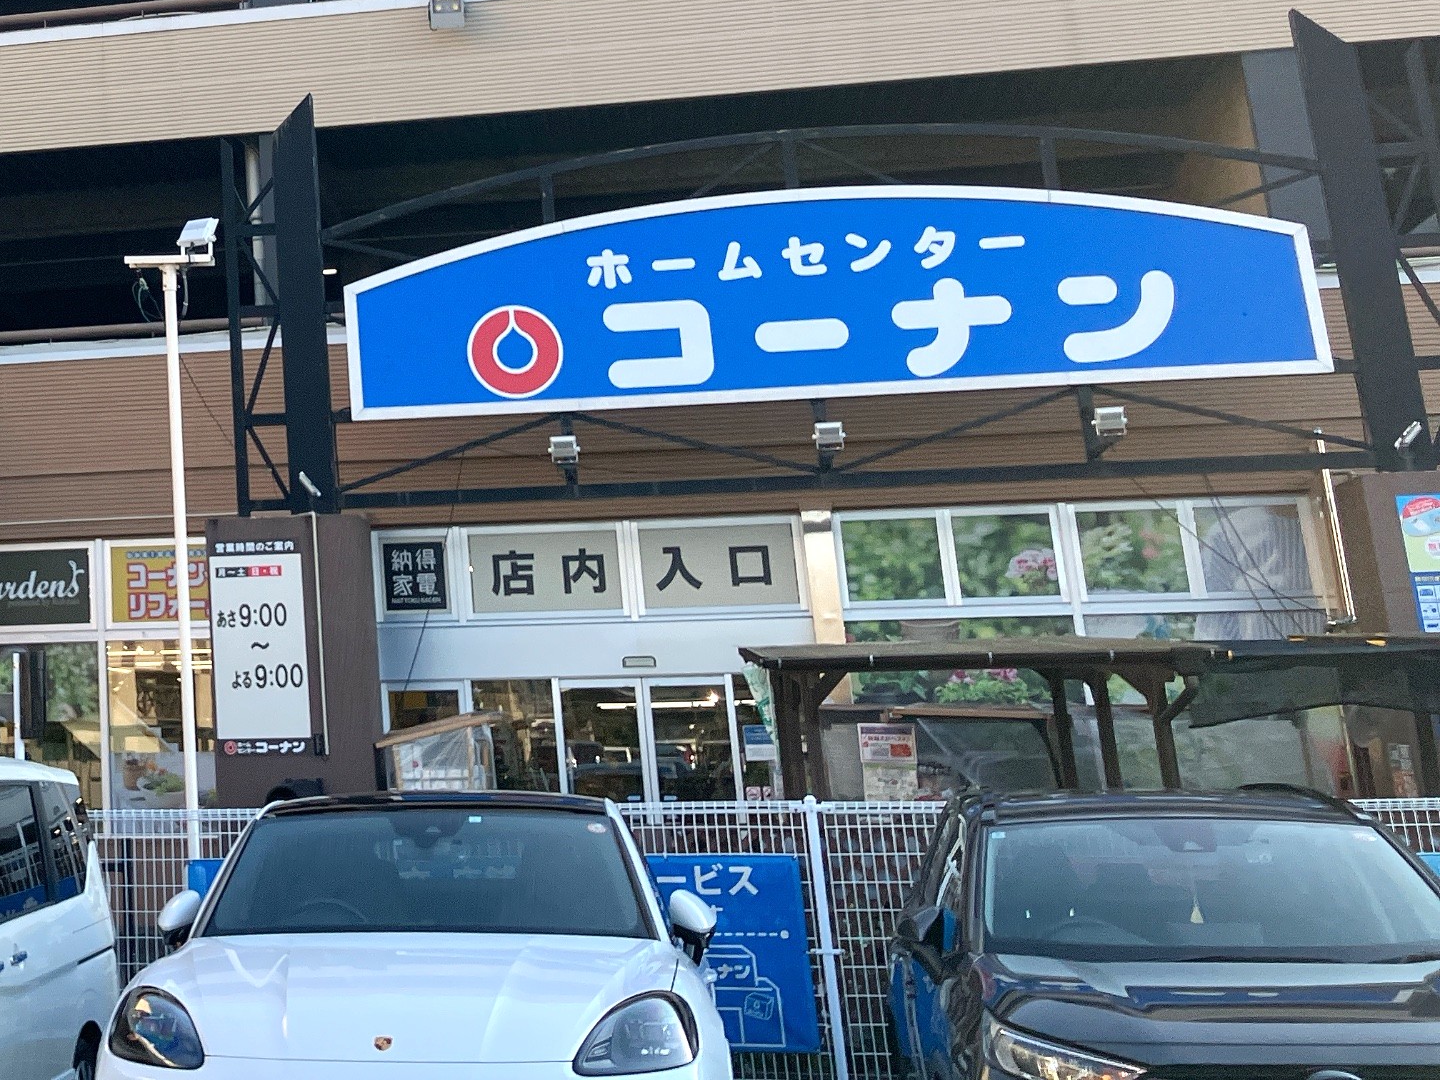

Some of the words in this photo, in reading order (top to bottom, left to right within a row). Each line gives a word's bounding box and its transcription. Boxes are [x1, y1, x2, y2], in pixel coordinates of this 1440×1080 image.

[586, 227, 1025, 289] ホームセンター
[602, 270, 1175, 387] コーナン
[391, 548, 436, 571] 納得
[492, 544, 773, 597] 店内入口
[392, 573, 438, 596] 家電
[255, 741, 305, 753] コーナン
[656, 863, 759, 896] ービス
[717, 963, 751, 979] ナン
